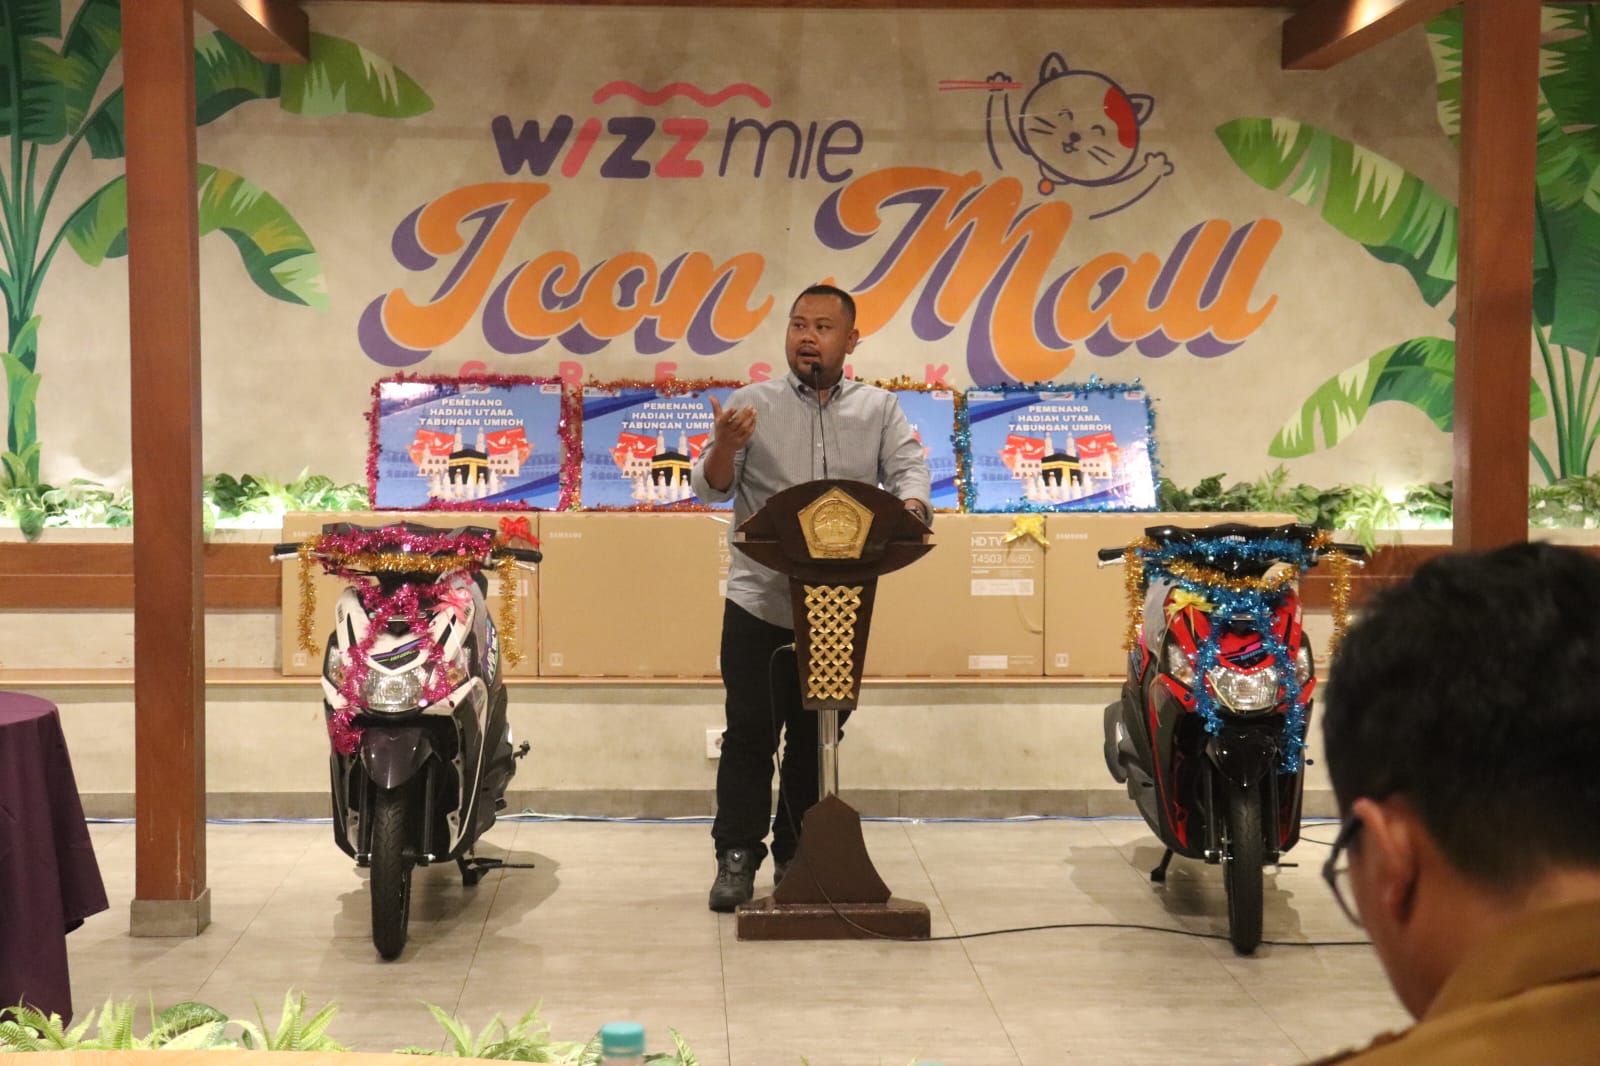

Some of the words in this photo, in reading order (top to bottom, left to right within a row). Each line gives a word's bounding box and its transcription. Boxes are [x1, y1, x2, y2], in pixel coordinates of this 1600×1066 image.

[358, 181, 774, 366] Icon
[814, 165, 1283, 392] Mall
[430, 408, 472, 416] HADIAH
[475, 408, 513, 416] UTAMA
[632, 412, 673, 420] HADIAH
[677, 412, 714, 420] UTAMA
[419, 418, 480, 426] TABUNGAN
[484, 418, 524, 426] UMROH
[621, 421, 682, 429] TABUNGAN
[685, 421, 714, 429] UMR
[971, 536, 987, 547] HD
